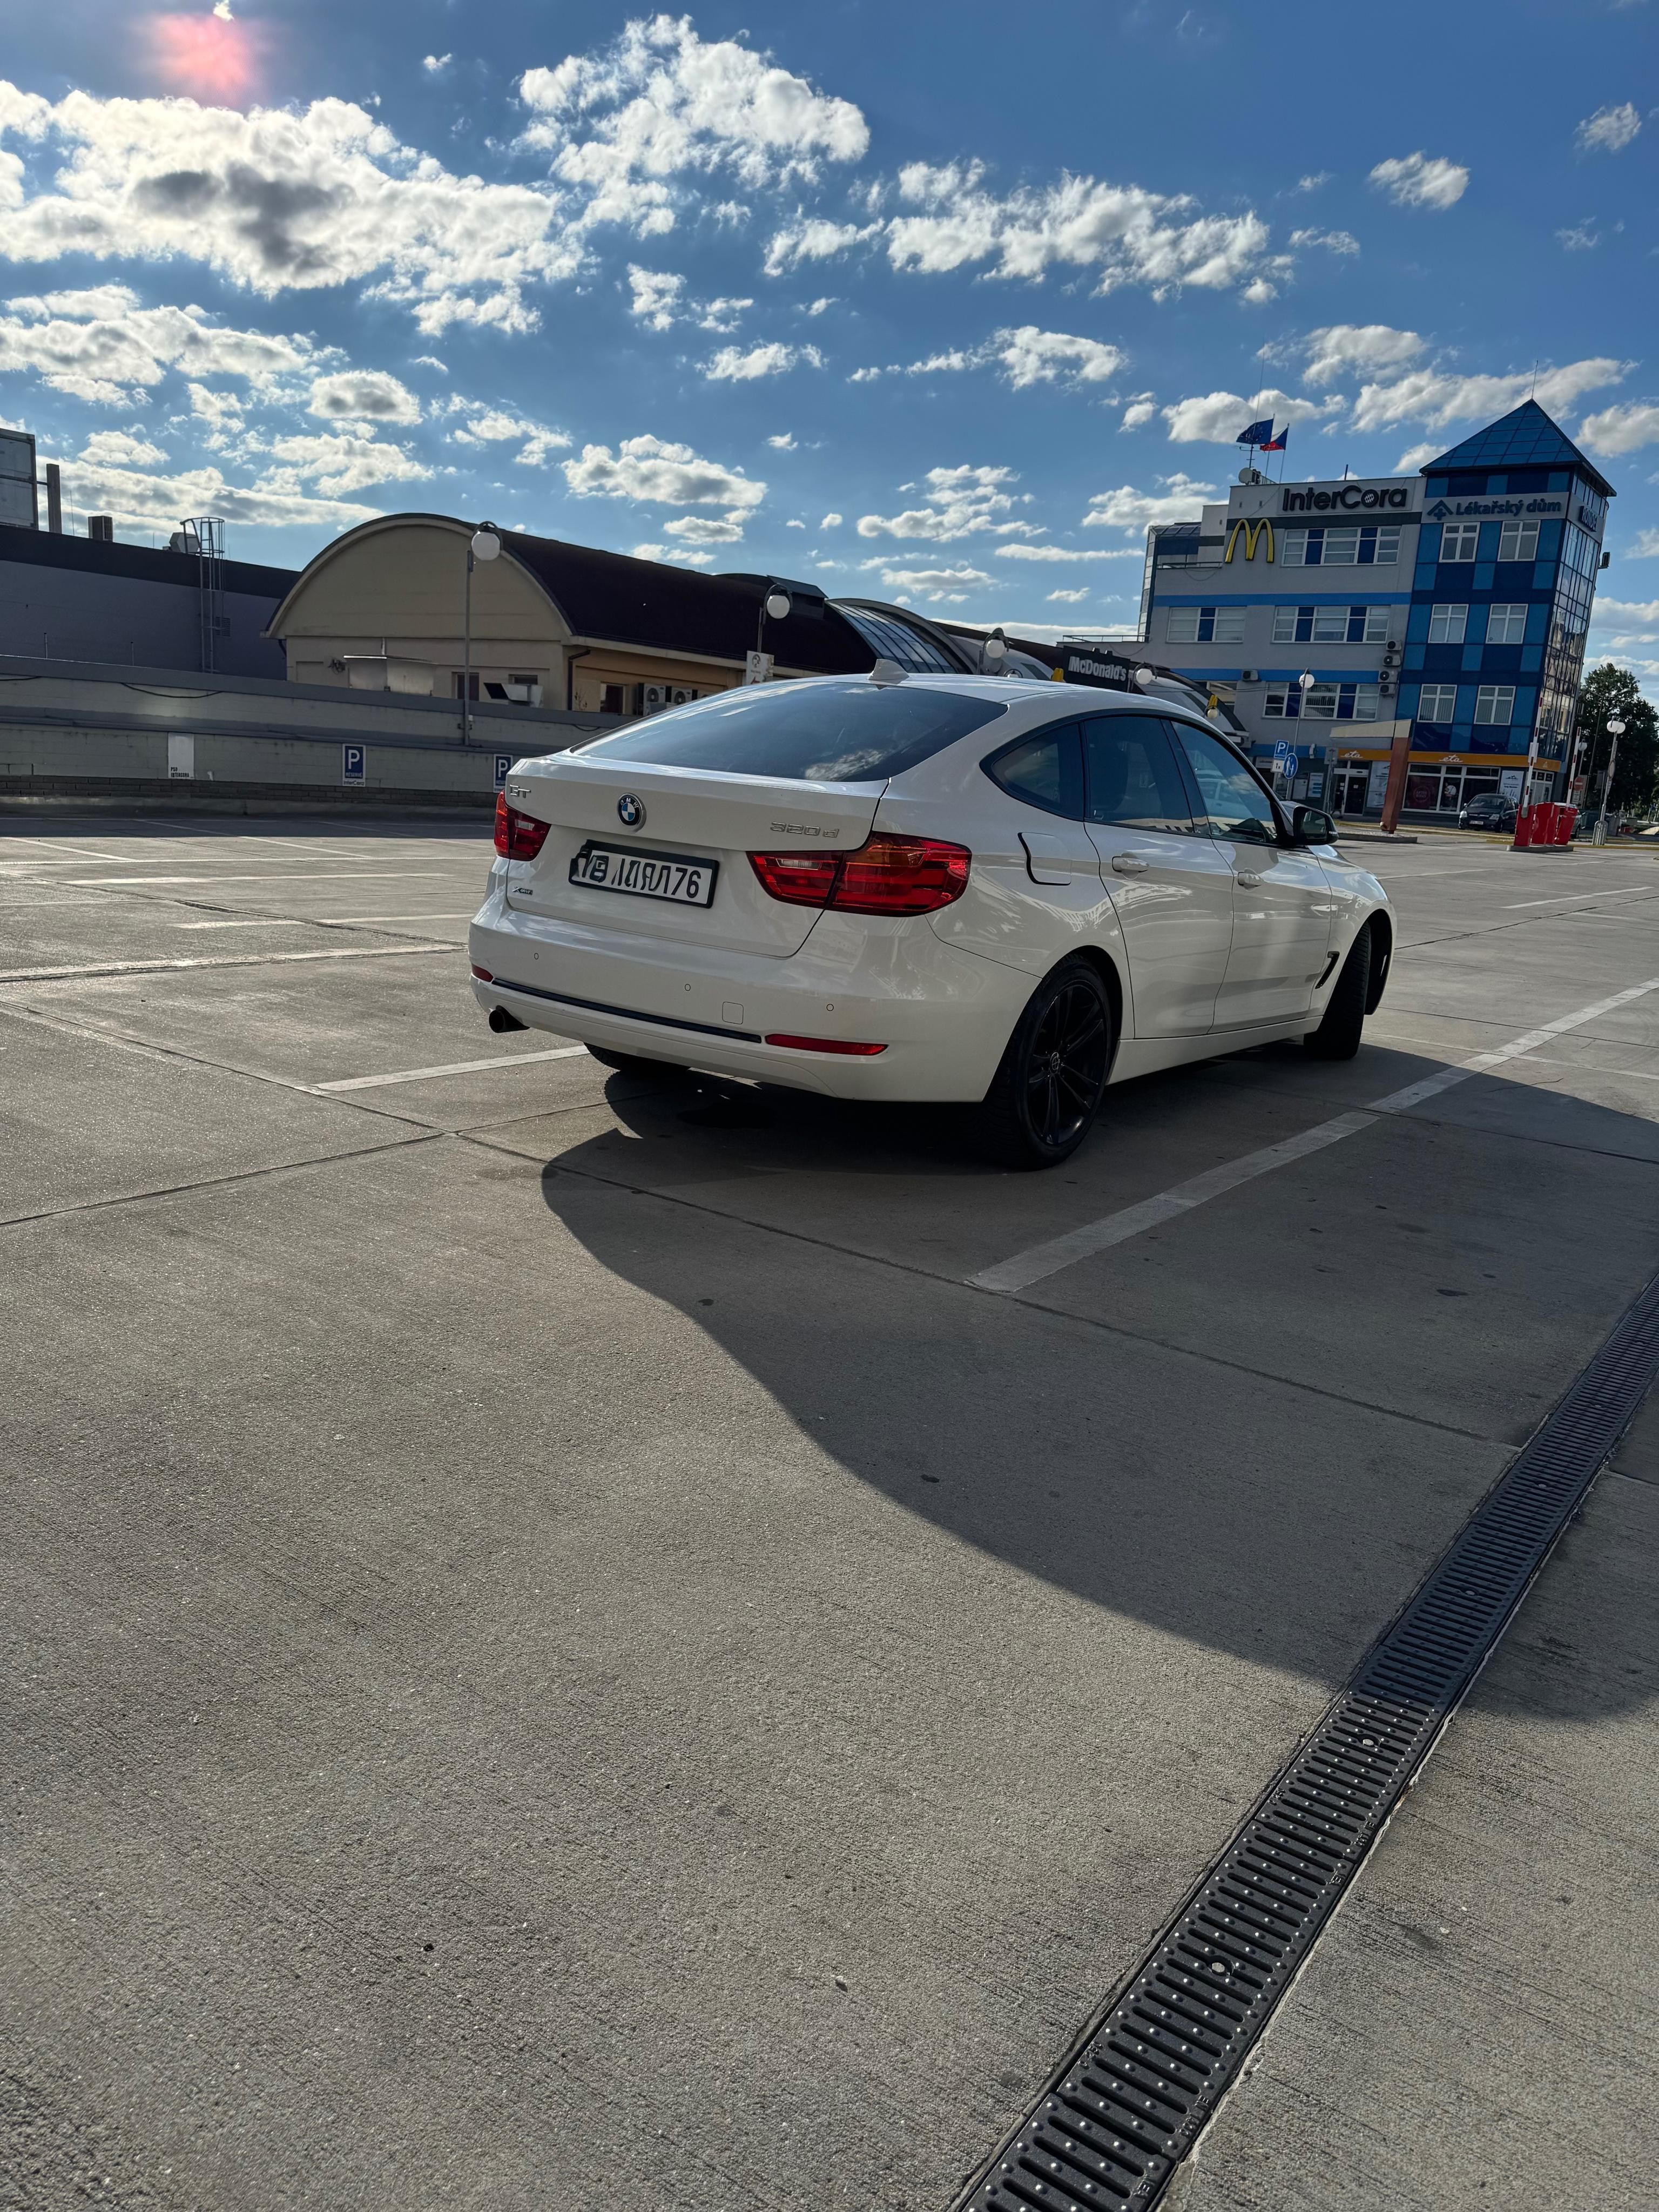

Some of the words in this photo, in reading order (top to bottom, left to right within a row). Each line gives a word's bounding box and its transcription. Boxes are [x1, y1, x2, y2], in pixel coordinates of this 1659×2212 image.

[1283, 485, 1407, 511] InterCora
[1455, 500, 1524, 517] Lékařský
[1526, 498, 1561, 513] dům
[1068, 656, 1127, 682] McDonald's
[1277, 742, 1286, 753] P
[1340, 750, 1363, 758] eta
[348, 749, 360, 769] P
[1439, 754, 1463, 763] eta
[498, 759, 508, 778] P
[510, 784, 531, 798] GT
